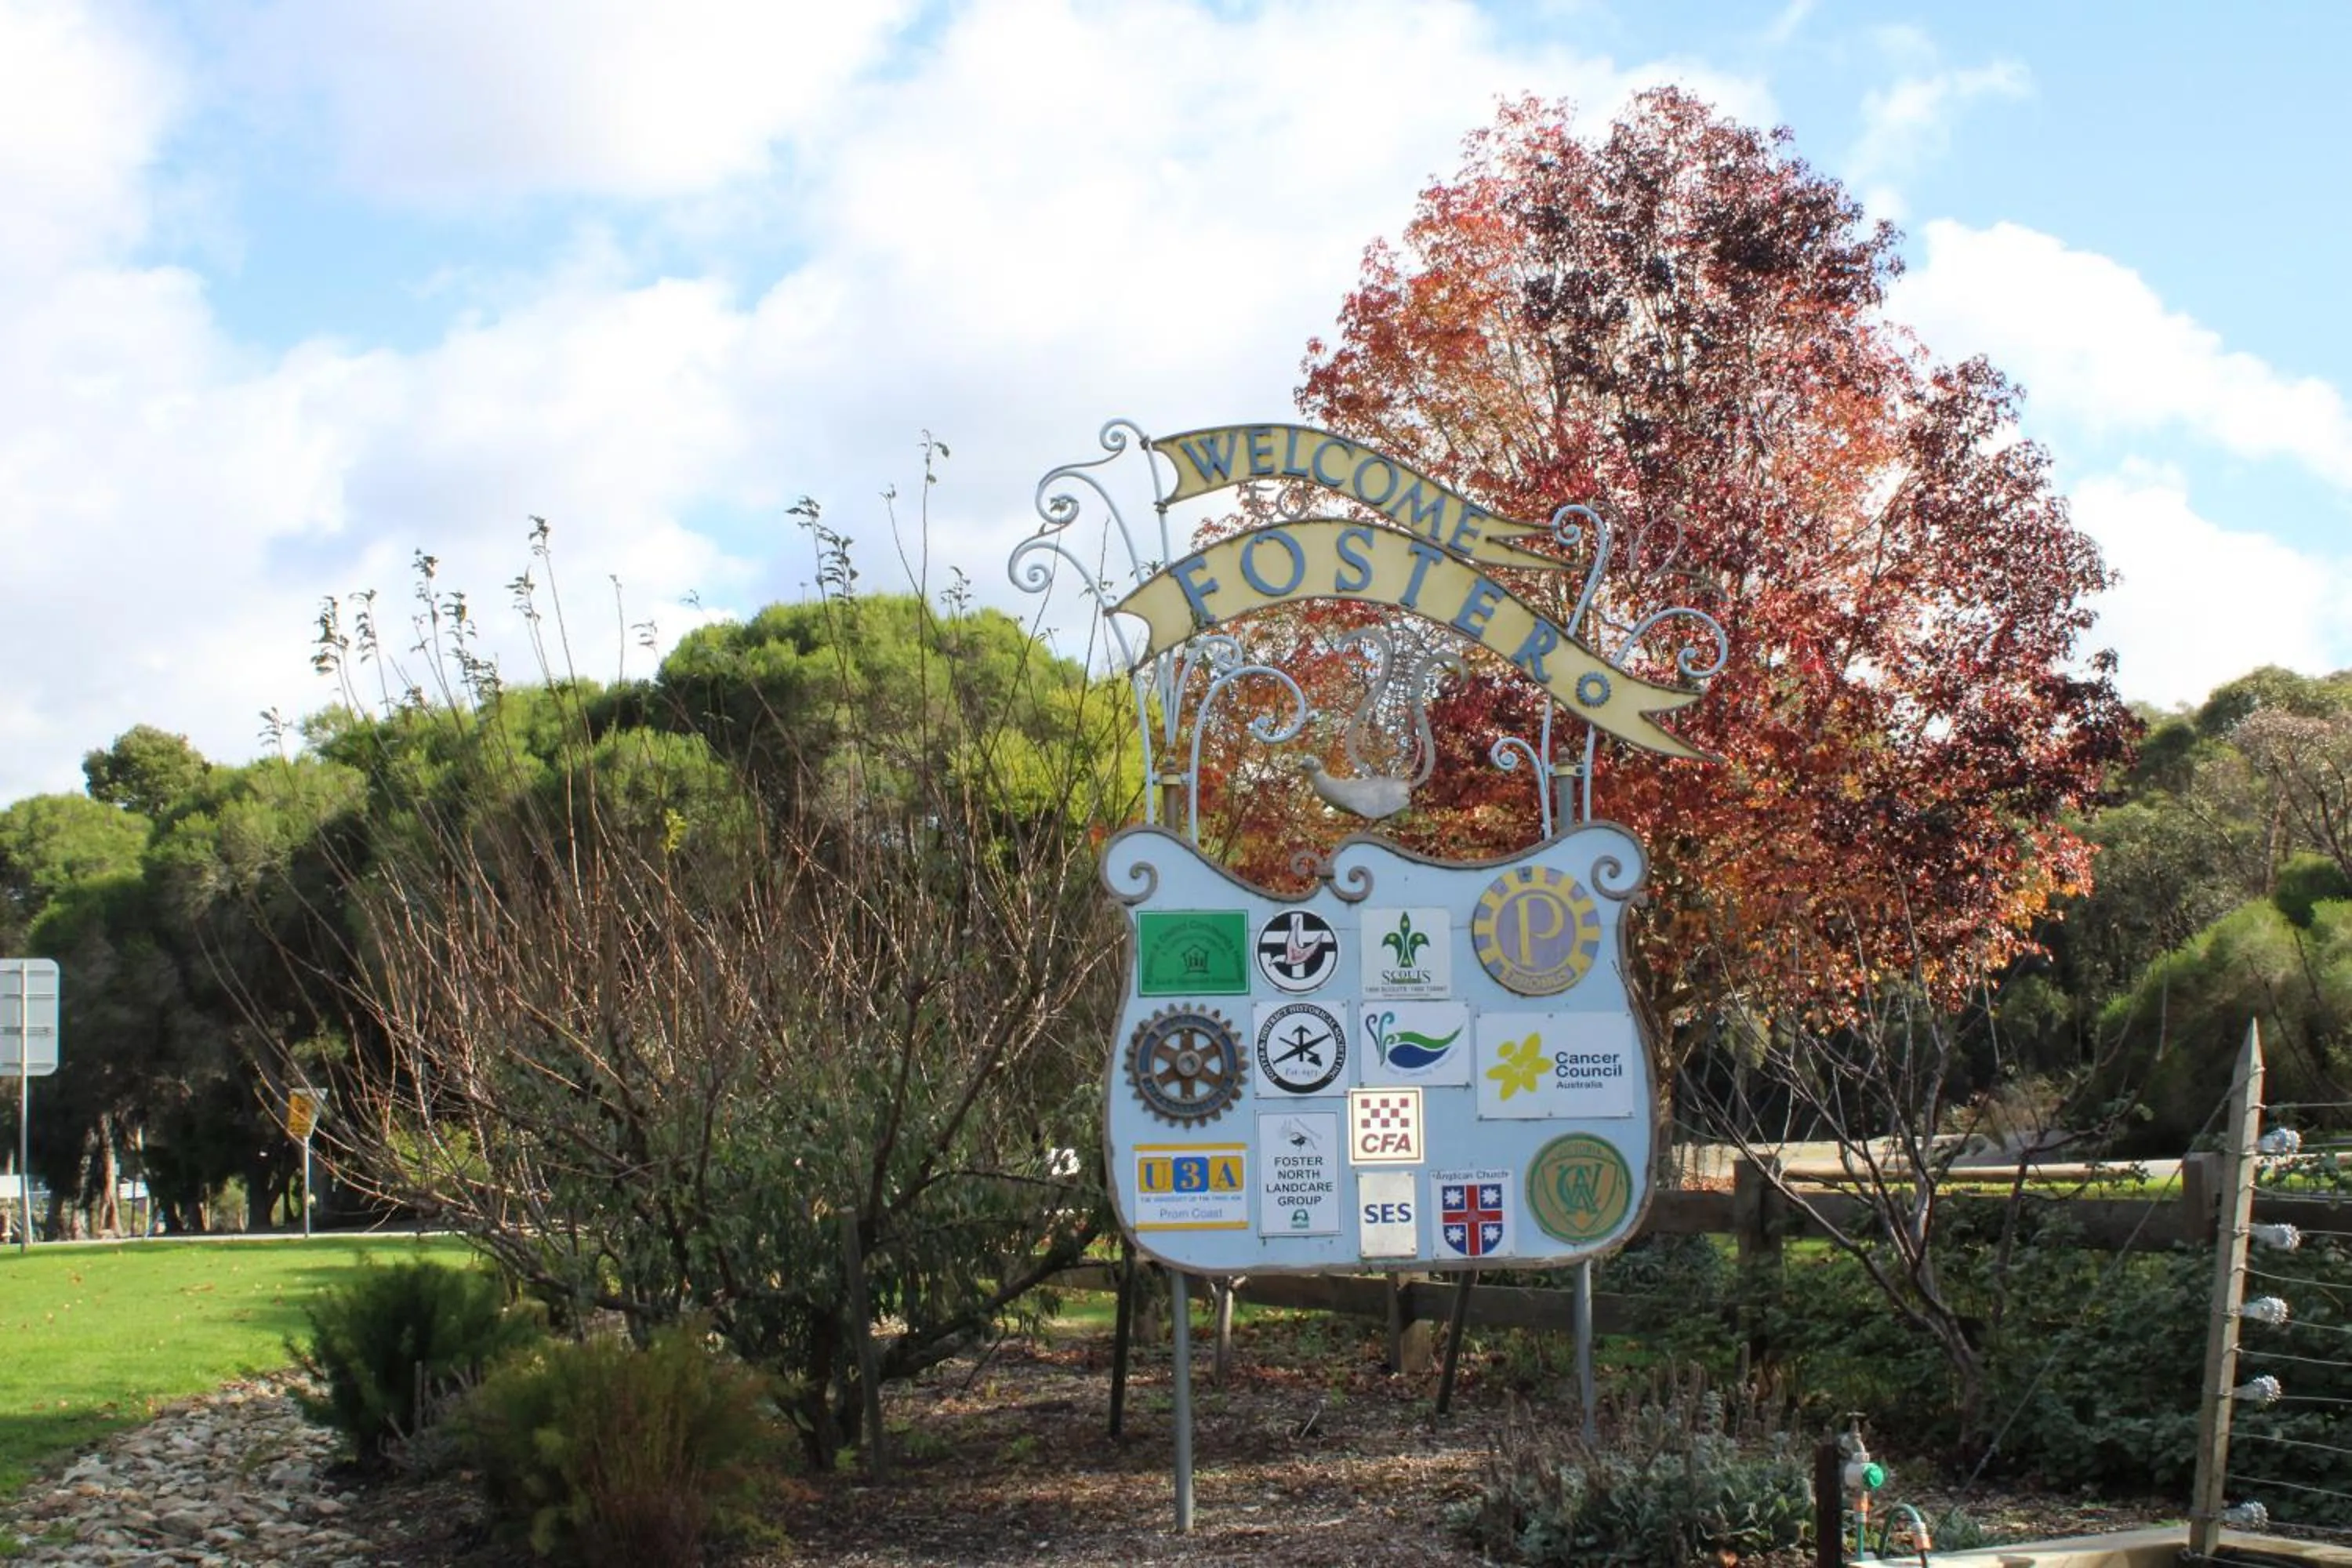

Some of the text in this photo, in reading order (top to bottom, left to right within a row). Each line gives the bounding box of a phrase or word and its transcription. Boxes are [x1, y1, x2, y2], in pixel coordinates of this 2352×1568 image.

[1181, 426, 1488, 554] WELCOME
[1171, 526, 1559, 684] FOSTER
[1555, 1051, 1620, 1064] Cancer
[1555, 1065, 1622, 1078] Council
[1361, 1133, 1411, 1152] CFA
[1274, 1156, 1323, 1167] FOSTER
[1143, 1160, 1237, 1189] U3A
[1278, 1170, 1320, 1179] NORTH
[1436, 1171, 1507, 1181] Anglican Church
[1266, 1182, 1333, 1192] LANDCARE
[1278, 1196, 1322, 1206] GROUP
[1364, 1203, 1411, 1224] SES
